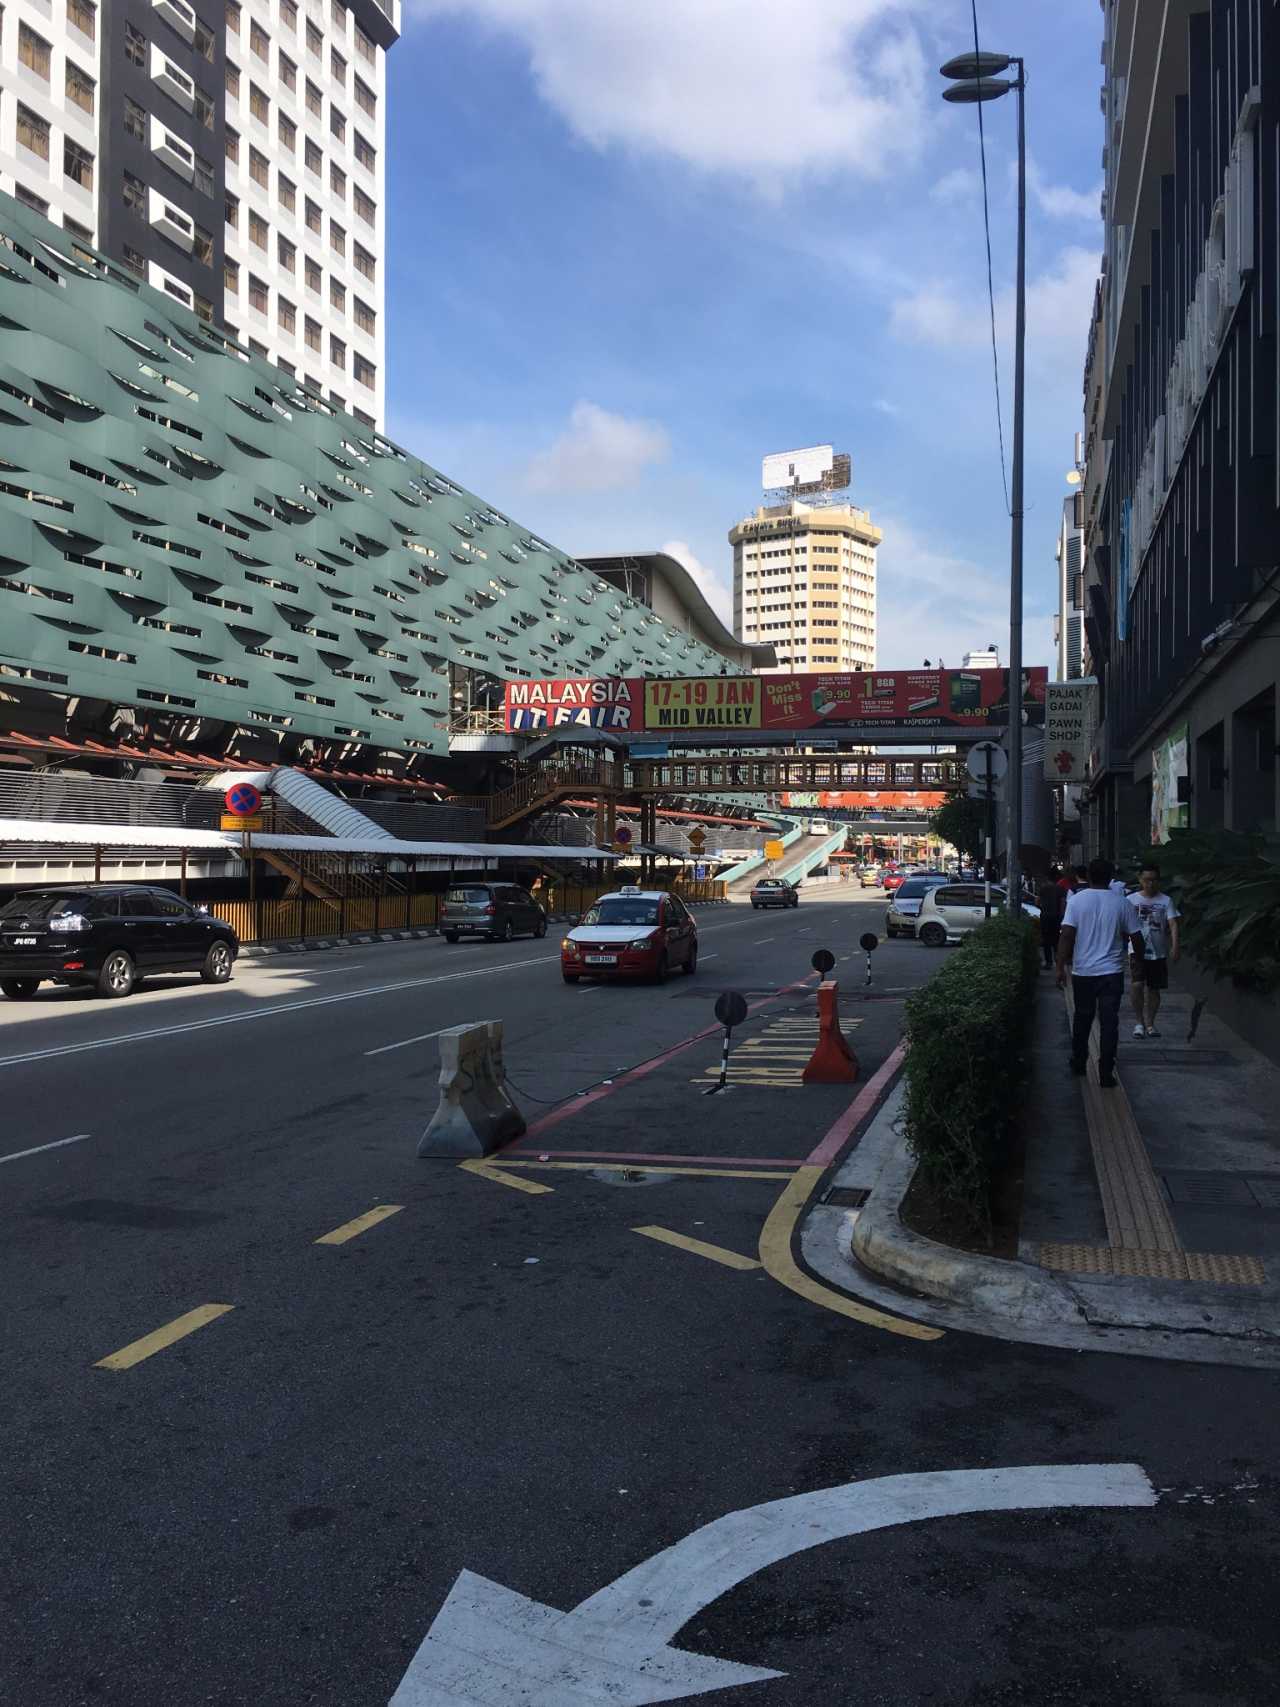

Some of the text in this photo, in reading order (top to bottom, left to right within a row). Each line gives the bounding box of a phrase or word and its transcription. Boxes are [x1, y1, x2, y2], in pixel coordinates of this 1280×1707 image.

[510, 682, 631, 704] MALAYSIA
[651, 681, 755, 705] 17-19 JAN
[767, 681, 800, 695] Don't
[1049, 689, 1082, 699] PAJAK
[772, 693, 802, 705] Miss
[1049, 701, 1082, 711] GADAI
[513, 705, 631, 729] IT FAIR
[659, 707, 752, 725] MID VALLEY
[1049, 719, 1082, 728] PAWN
[1049, 731, 1081, 741] SHOP
